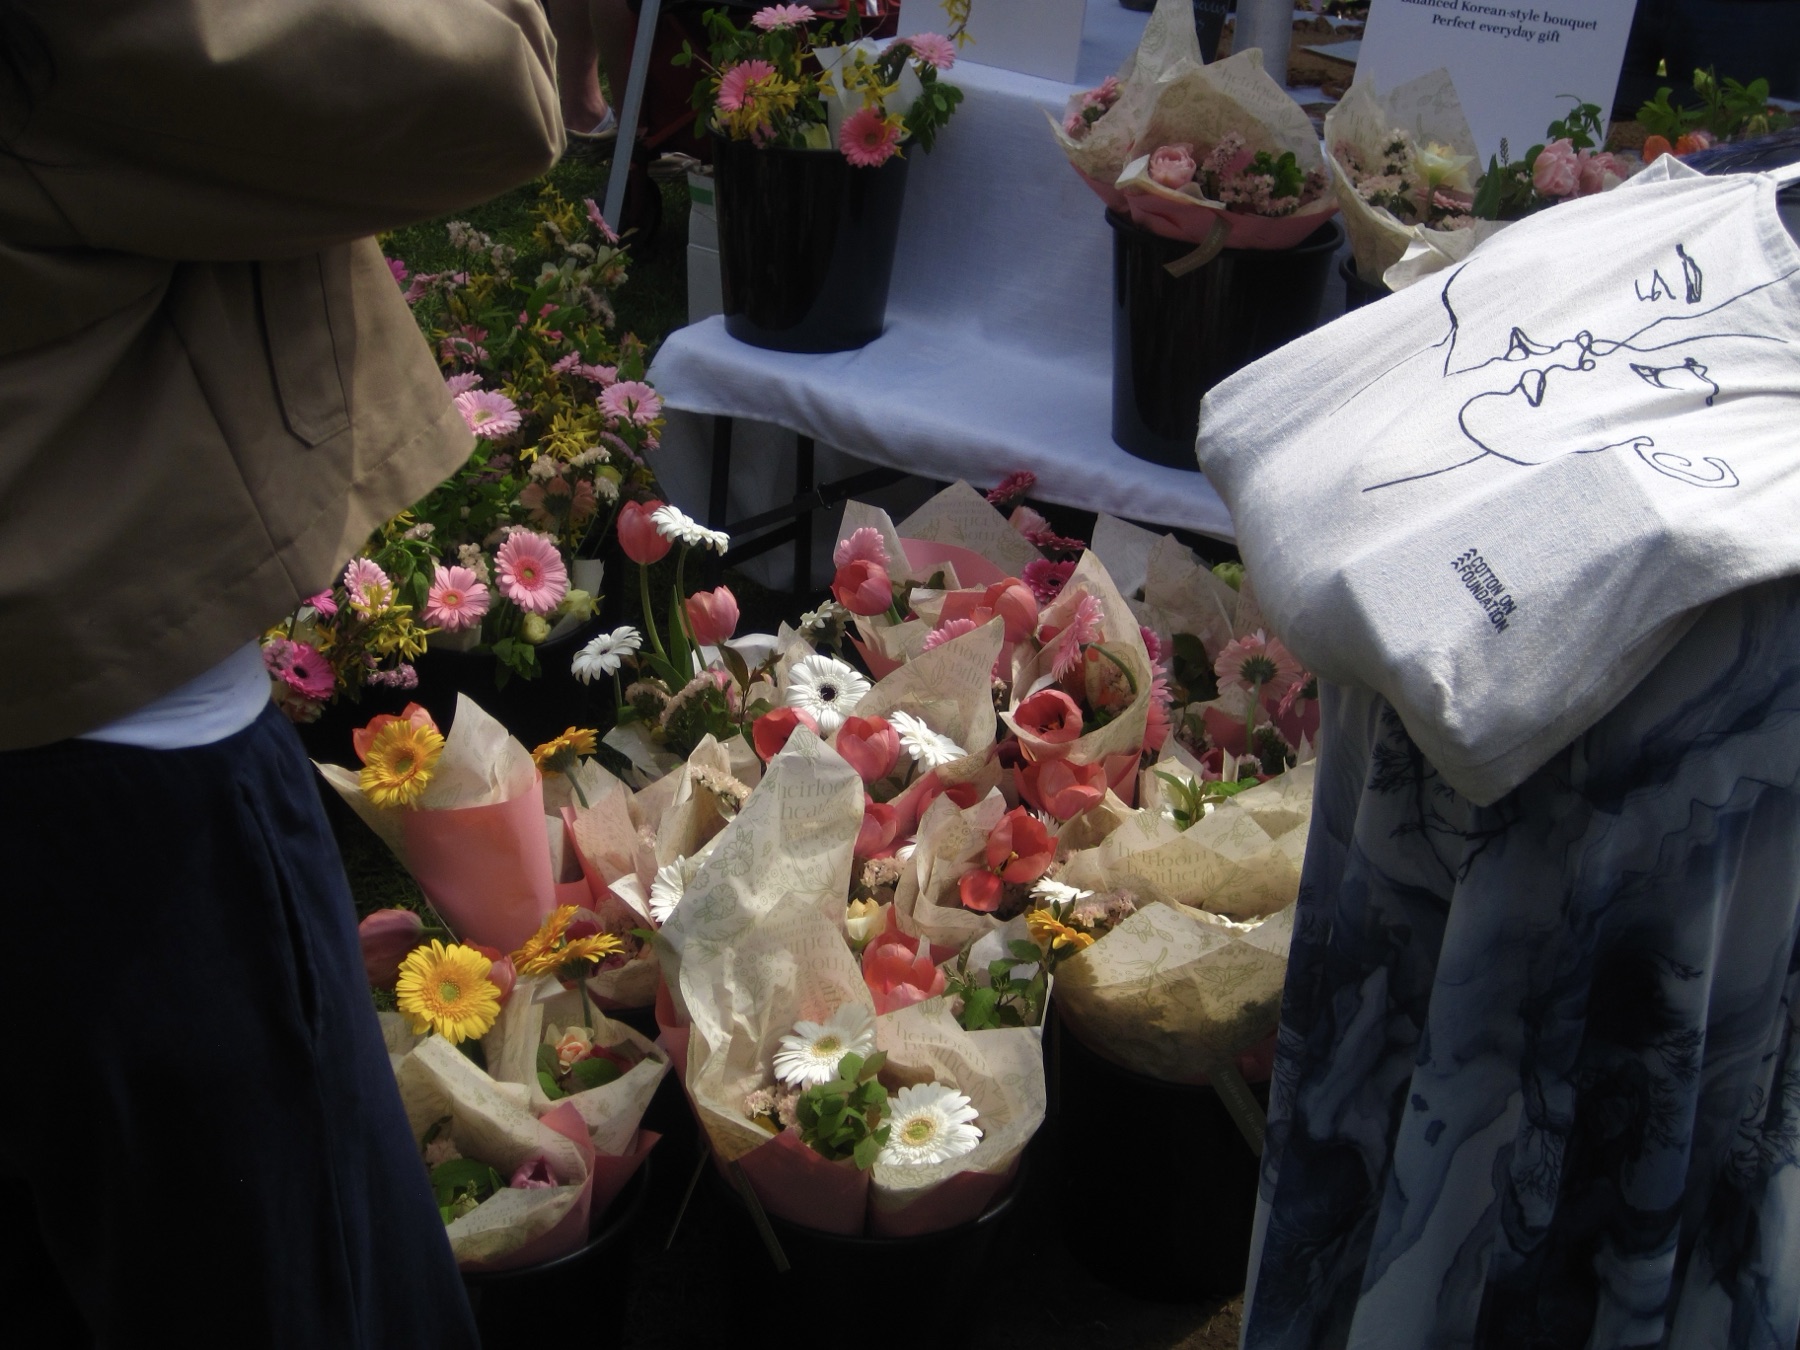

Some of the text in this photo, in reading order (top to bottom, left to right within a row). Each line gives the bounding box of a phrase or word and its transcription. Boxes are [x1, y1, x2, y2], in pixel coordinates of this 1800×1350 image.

[1401, 0, 1598, 31] anced Korean-style bouquet
[1432, 14, 1560, 43] Perfect everyday gift
[1457, 564, 1510, 634] FOUNDATION
[1470, 556, 1518, 616] COTTON ON
[1118, 841, 1207, 867] heirloom
[1127, 860, 1198, 883] heather
[896, 1021, 986, 1070] heirloom
